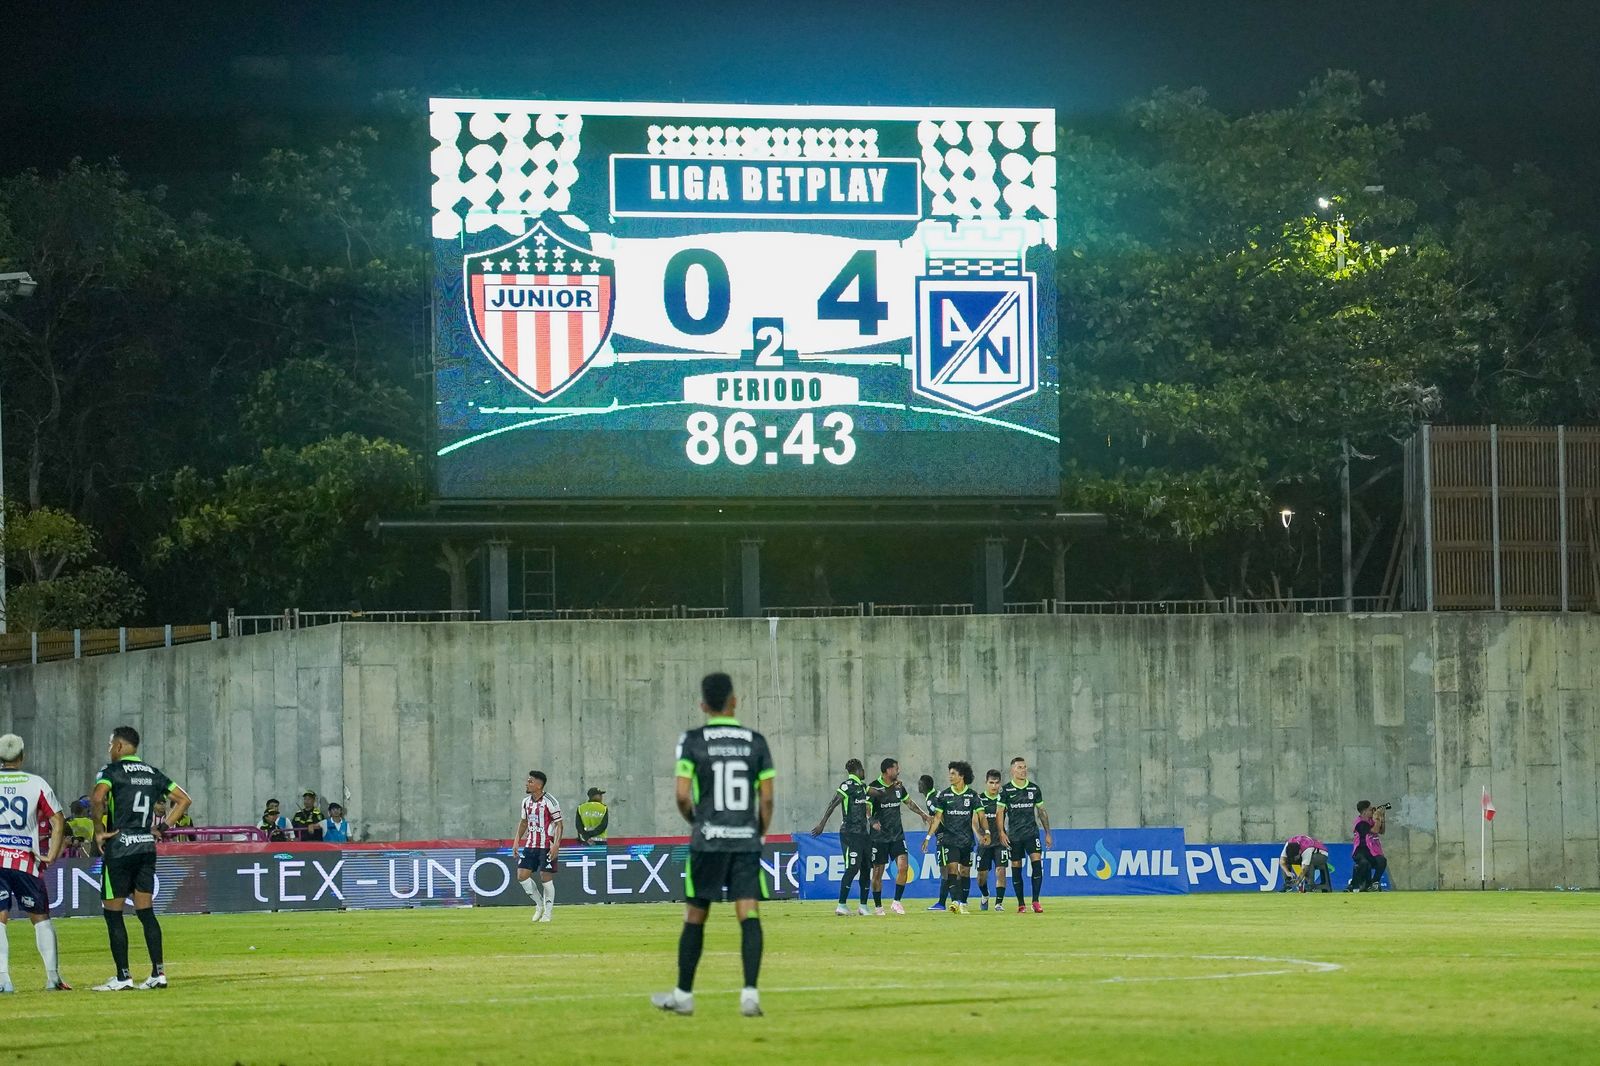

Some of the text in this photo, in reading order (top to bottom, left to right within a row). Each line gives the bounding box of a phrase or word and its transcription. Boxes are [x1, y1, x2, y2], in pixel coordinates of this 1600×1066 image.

[649, 165, 889, 204] LIGA BETPLAY
[490, 288, 593, 309] JUNIOR
[662, 247, 889, 336] 0 4
[755, 326, 784, 367] 2
[716, 377, 822, 403] PERIODO
[685, 410, 857, 466] 86:43
[711, 761, 750, 812] 16
[0, 795, 29, 831] 29
[132, 790, 150, 828] 4
[0, 849, 20, 859] laro
[1185, 847, 1280, 892] Play
